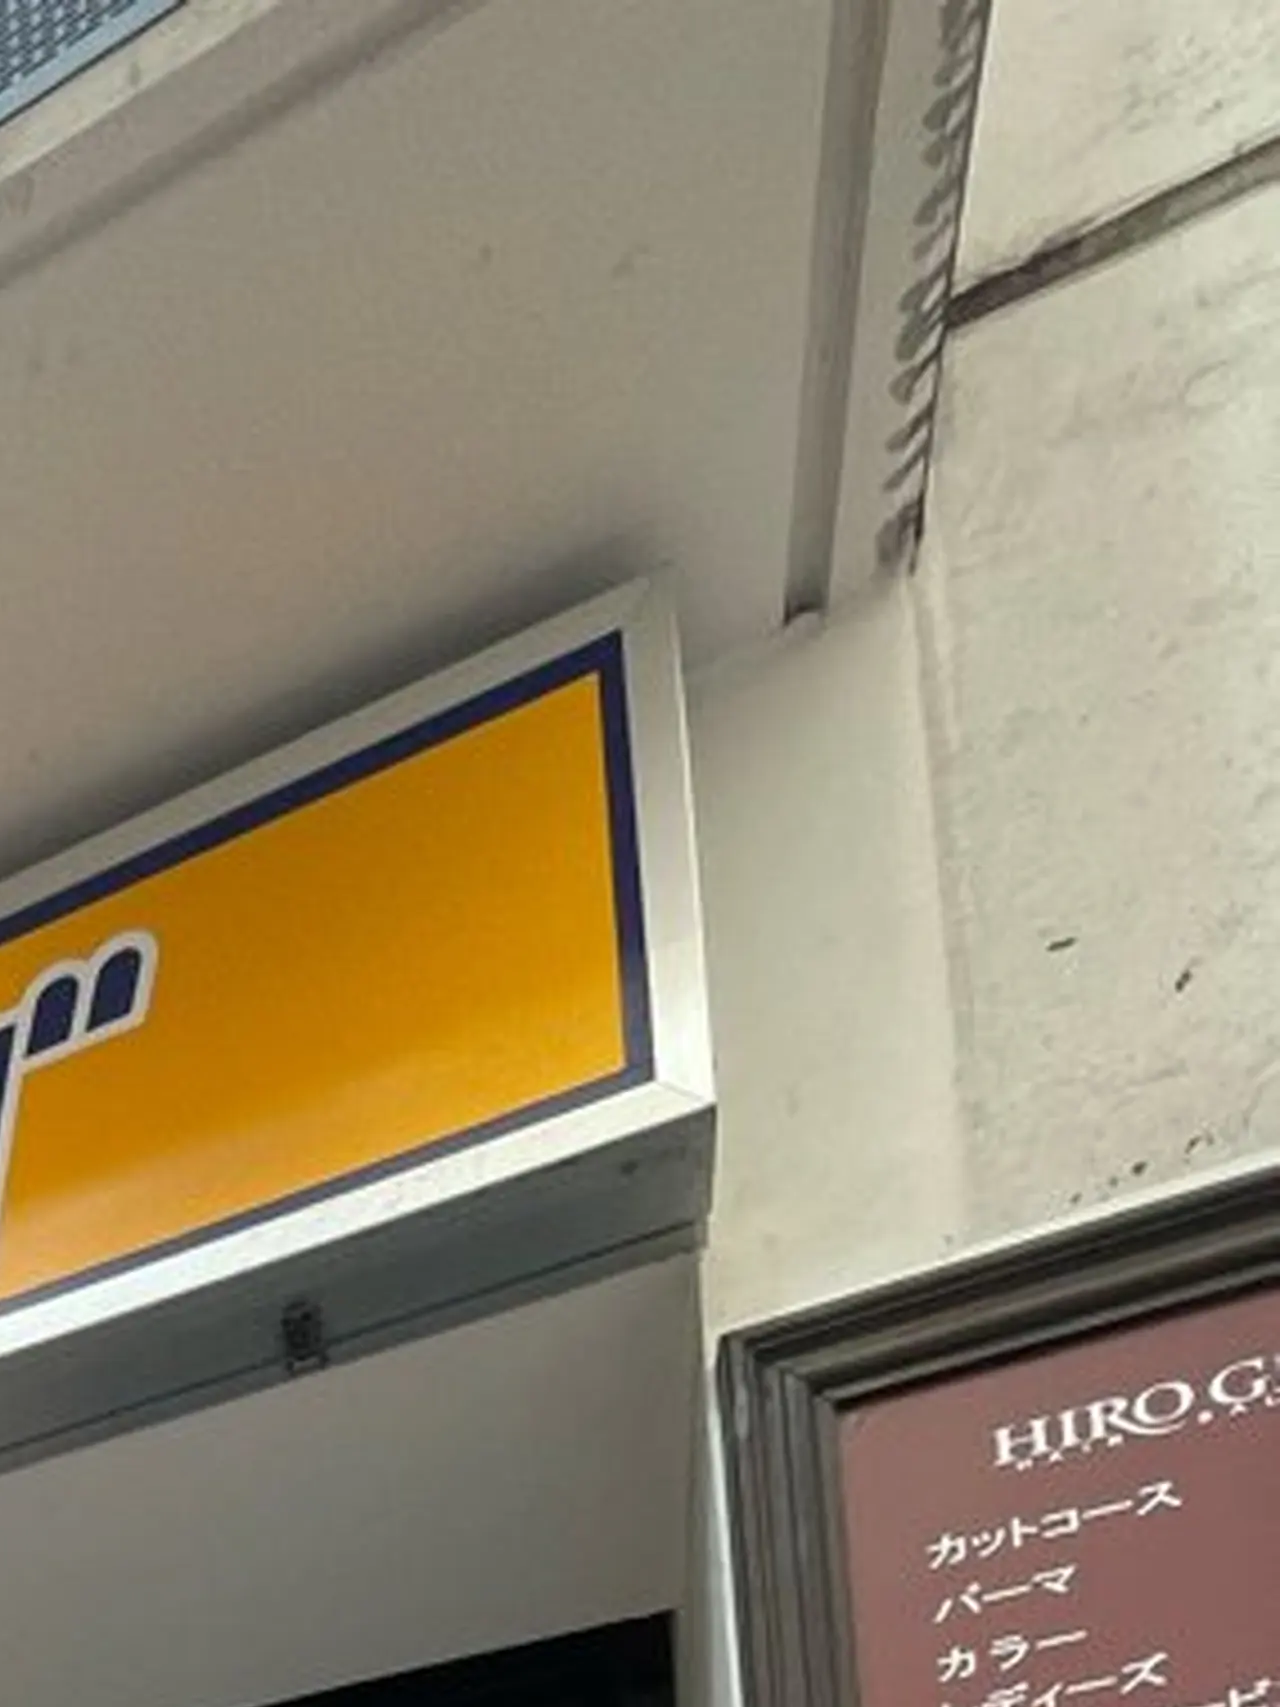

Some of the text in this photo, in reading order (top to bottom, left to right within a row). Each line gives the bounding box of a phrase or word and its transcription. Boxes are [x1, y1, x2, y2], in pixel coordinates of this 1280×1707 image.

[993, 1355, 1280, 1467] HIRO.G
[926, 1480, 1183, 1570] カットコース
[937, 1630, 1088, 1683] カラー
